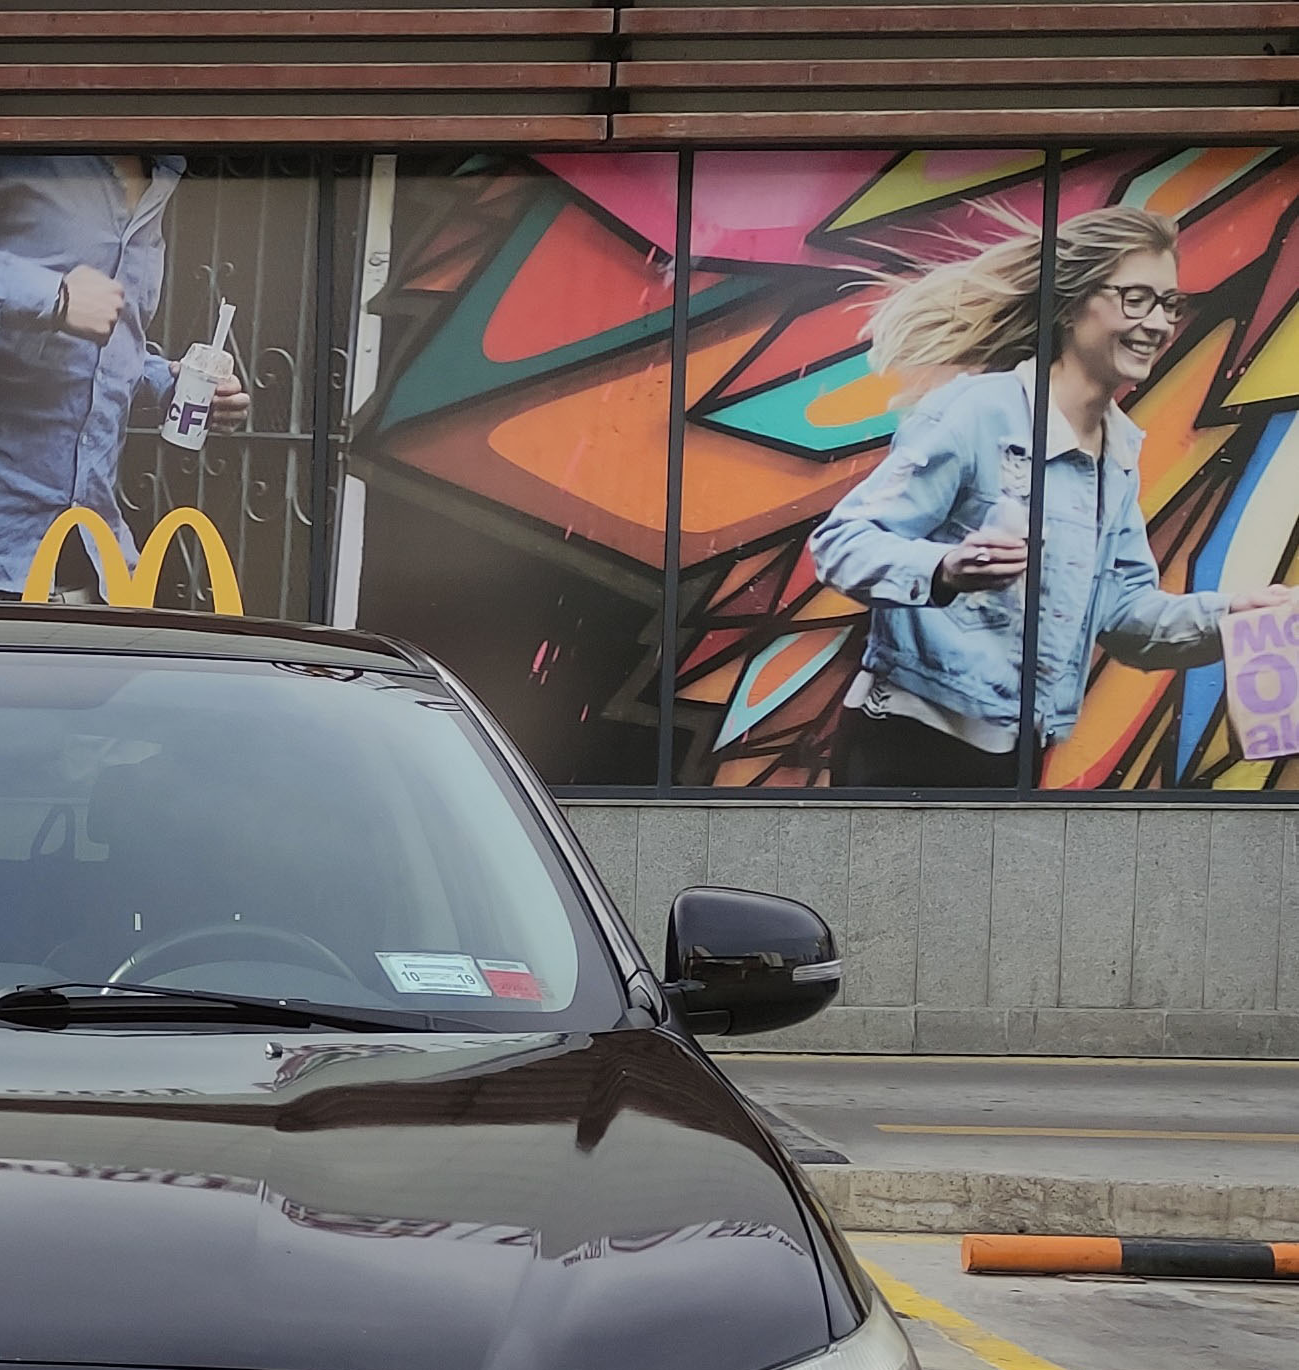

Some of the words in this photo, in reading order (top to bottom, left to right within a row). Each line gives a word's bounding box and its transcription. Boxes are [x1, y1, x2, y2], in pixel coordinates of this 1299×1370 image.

[1245, 714, 1299, 755] al
[401, 969, 421, 983] 10
[456, 974, 476, 986] 19
